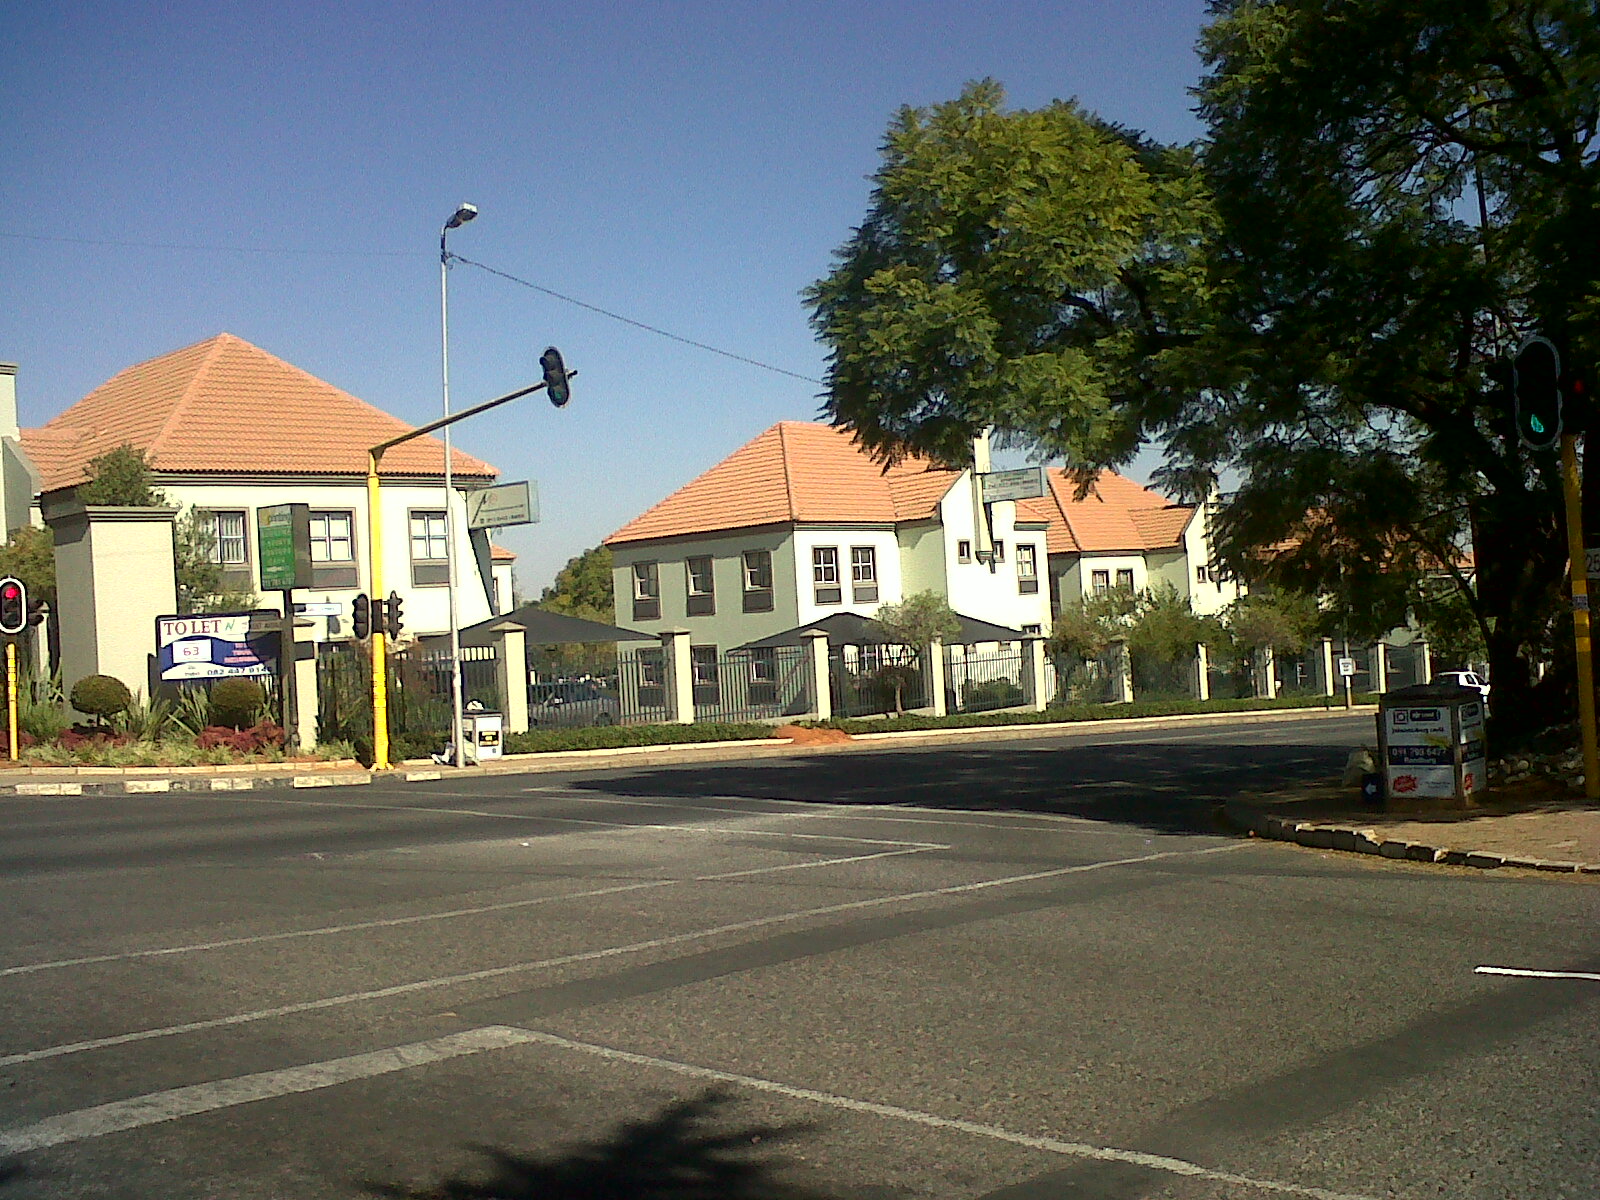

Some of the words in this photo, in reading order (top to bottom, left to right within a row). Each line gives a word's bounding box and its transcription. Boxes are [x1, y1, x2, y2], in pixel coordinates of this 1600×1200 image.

[164, 622, 187, 636] TO
[191, 620, 222, 634] LET
[183, 646, 200, 656] 63
